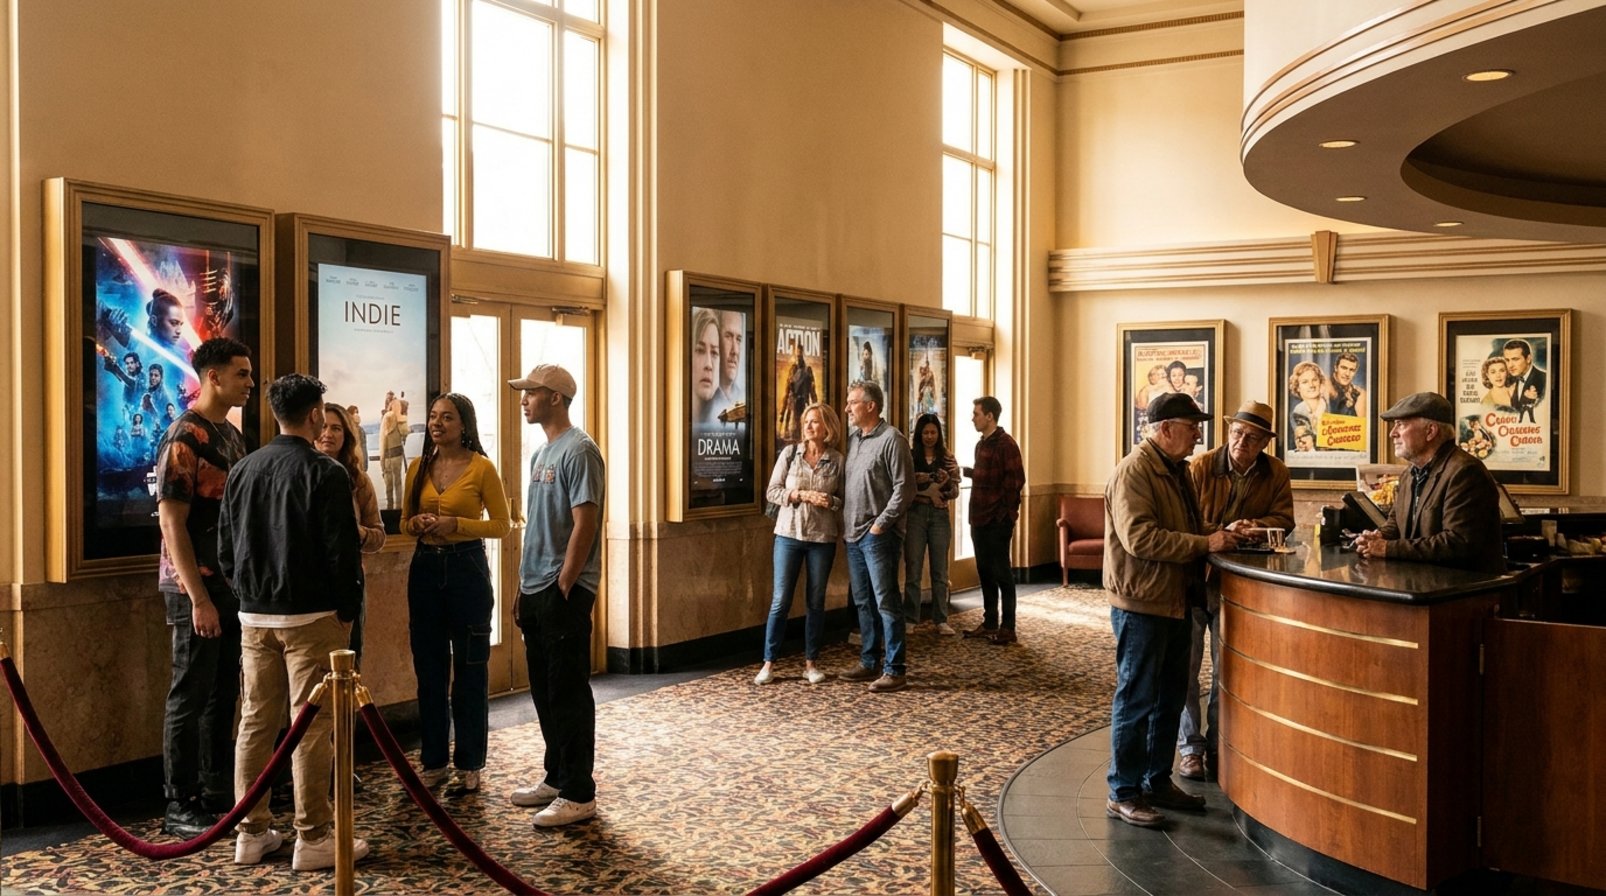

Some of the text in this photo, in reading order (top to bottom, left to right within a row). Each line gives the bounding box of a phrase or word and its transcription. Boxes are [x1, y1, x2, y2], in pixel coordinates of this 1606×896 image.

[345, 301, 401, 326] INDIE
[777, 328, 820, 357] ACTION
[697, 438, 740, 456] DRAMA
